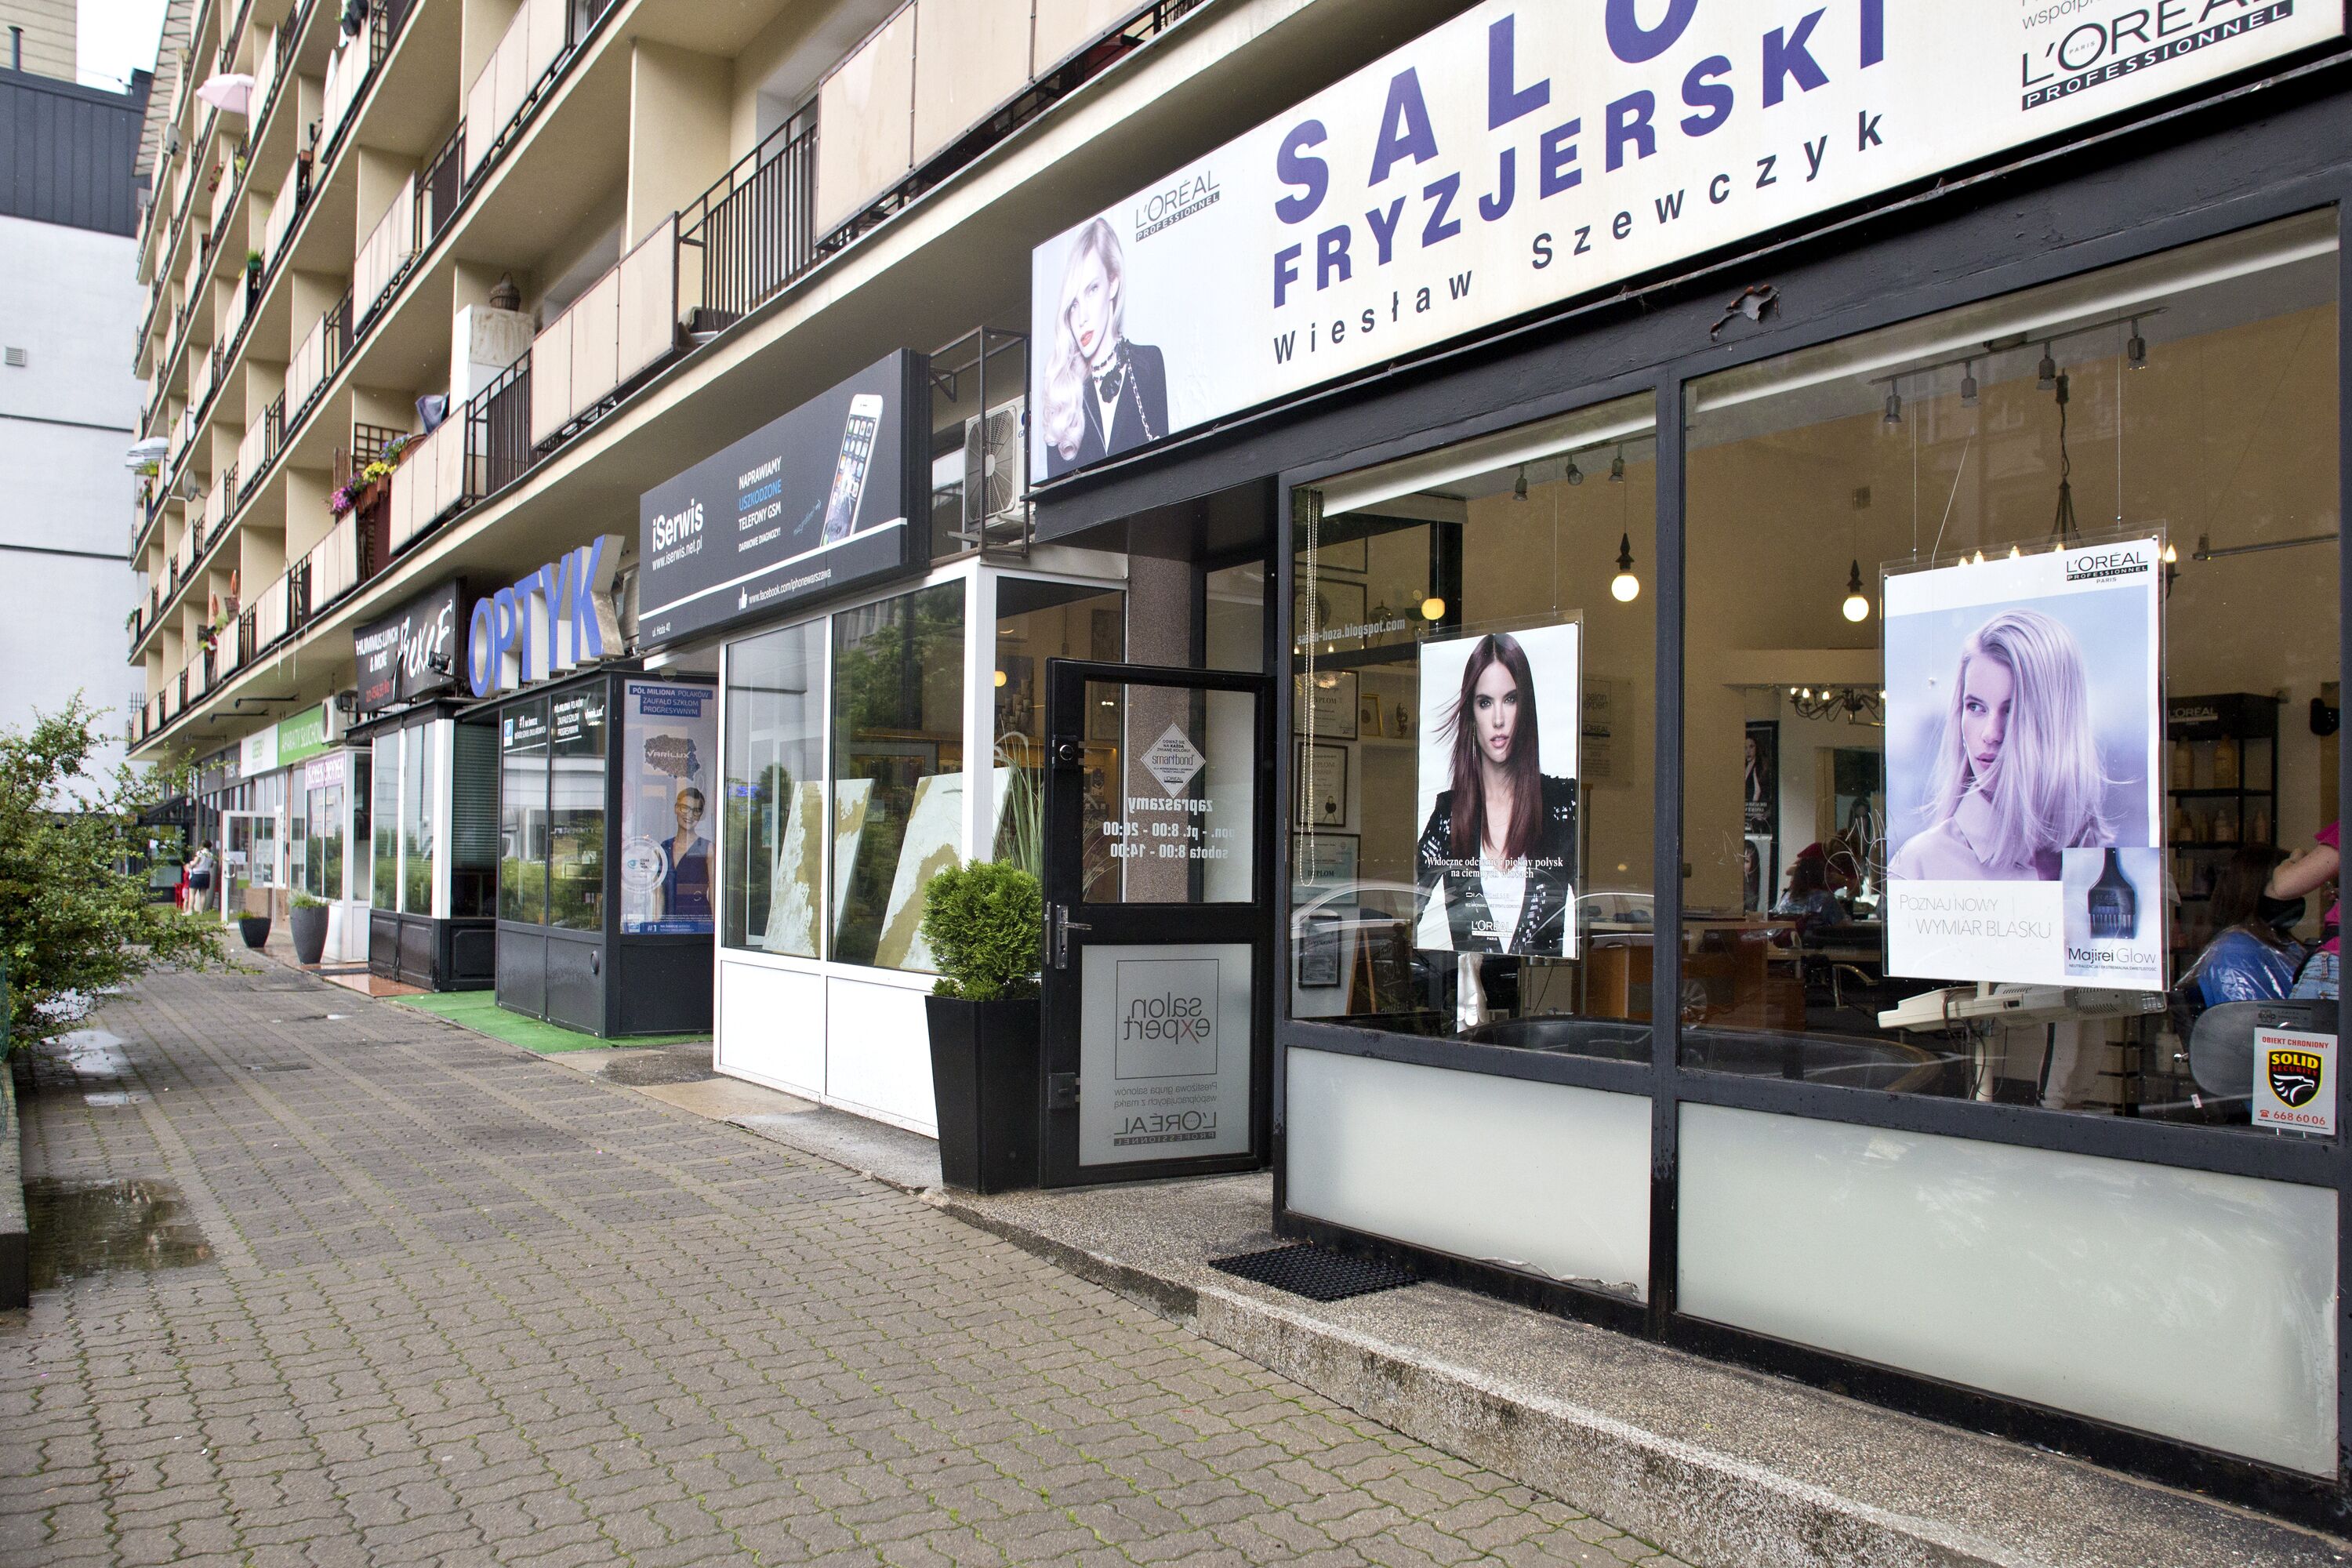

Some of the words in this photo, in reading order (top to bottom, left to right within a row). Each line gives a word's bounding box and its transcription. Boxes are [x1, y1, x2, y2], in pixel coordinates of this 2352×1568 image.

[2025, 5, 2288, 109] PROFESSIONNEL
[2068, 40, 2096, 55] PARIS
[1273, 0, 1884, 309] FRYZJERSKI
[1137, 192, 1219, 241] PROFESSIONNEL
[1274, 270, 1474, 365] Wiesław
[1531, 110, 1883, 270] Szewczyk
[739, 456, 782, 490] NAPRAWIAMY
[739, 478, 782, 511] USZKODZONE
[652, 498, 703, 553] iSerwis
[738, 509, 768, 532] TELEFONY
[768, 501, 782, 520] GSM
[652, 534, 702, 572] www.iserwis.net.pl
[2066, 551, 2148, 573] L'ORÉAL
[2067, 565, 2147, 580] PROFESSIONNEL
[748, 568, 832, 604] www.facebook.com/iphonewarszawa
[469, 534, 619, 698] OPTYK
[355, 632, 383, 657] HUMMUS
[382, 626, 399, 648] LUNCH
[632, 686, 645, 695] PÓŁ
[647, 688, 676, 696] MILIONA
[677, 689, 709, 698] POLAKÓW
[642, 697, 672, 706] ZAUFAŁO
[643, 706, 698, 715] PROGRESYWNYM
[1152, 753, 1193, 766] smartbond
[1427, 856, 1463, 868] Widoczne
[1504, 857, 1533, 869] piękny
[1534, 856, 1564, 871] połysk
[1461, 868, 1501, 880] ciemnych
[1501, 868, 1534, 879] włosach
[1954, 898, 1998, 913] NOWY
[1915, 918, 1982, 936] WYMIAR
[1986, 920, 2051, 939] BLASKU
[2068, 948, 2114, 964] Majirei
[2116, 947, 2157, 964] Glow
[2262, 1036, 2286, 1045] OBIEKT
[2287, 1039, 2329, 1049] CHRONIONY
[2270, 1053, 2319, 1069] SOLID
[2271, 1065, 2319, 1077] SECURITY
[2273, 1110, 2294, 1121] 668
[2296, 1112, 2310, 1123] 60
[2311, 1115, 2326, 1126] 06
